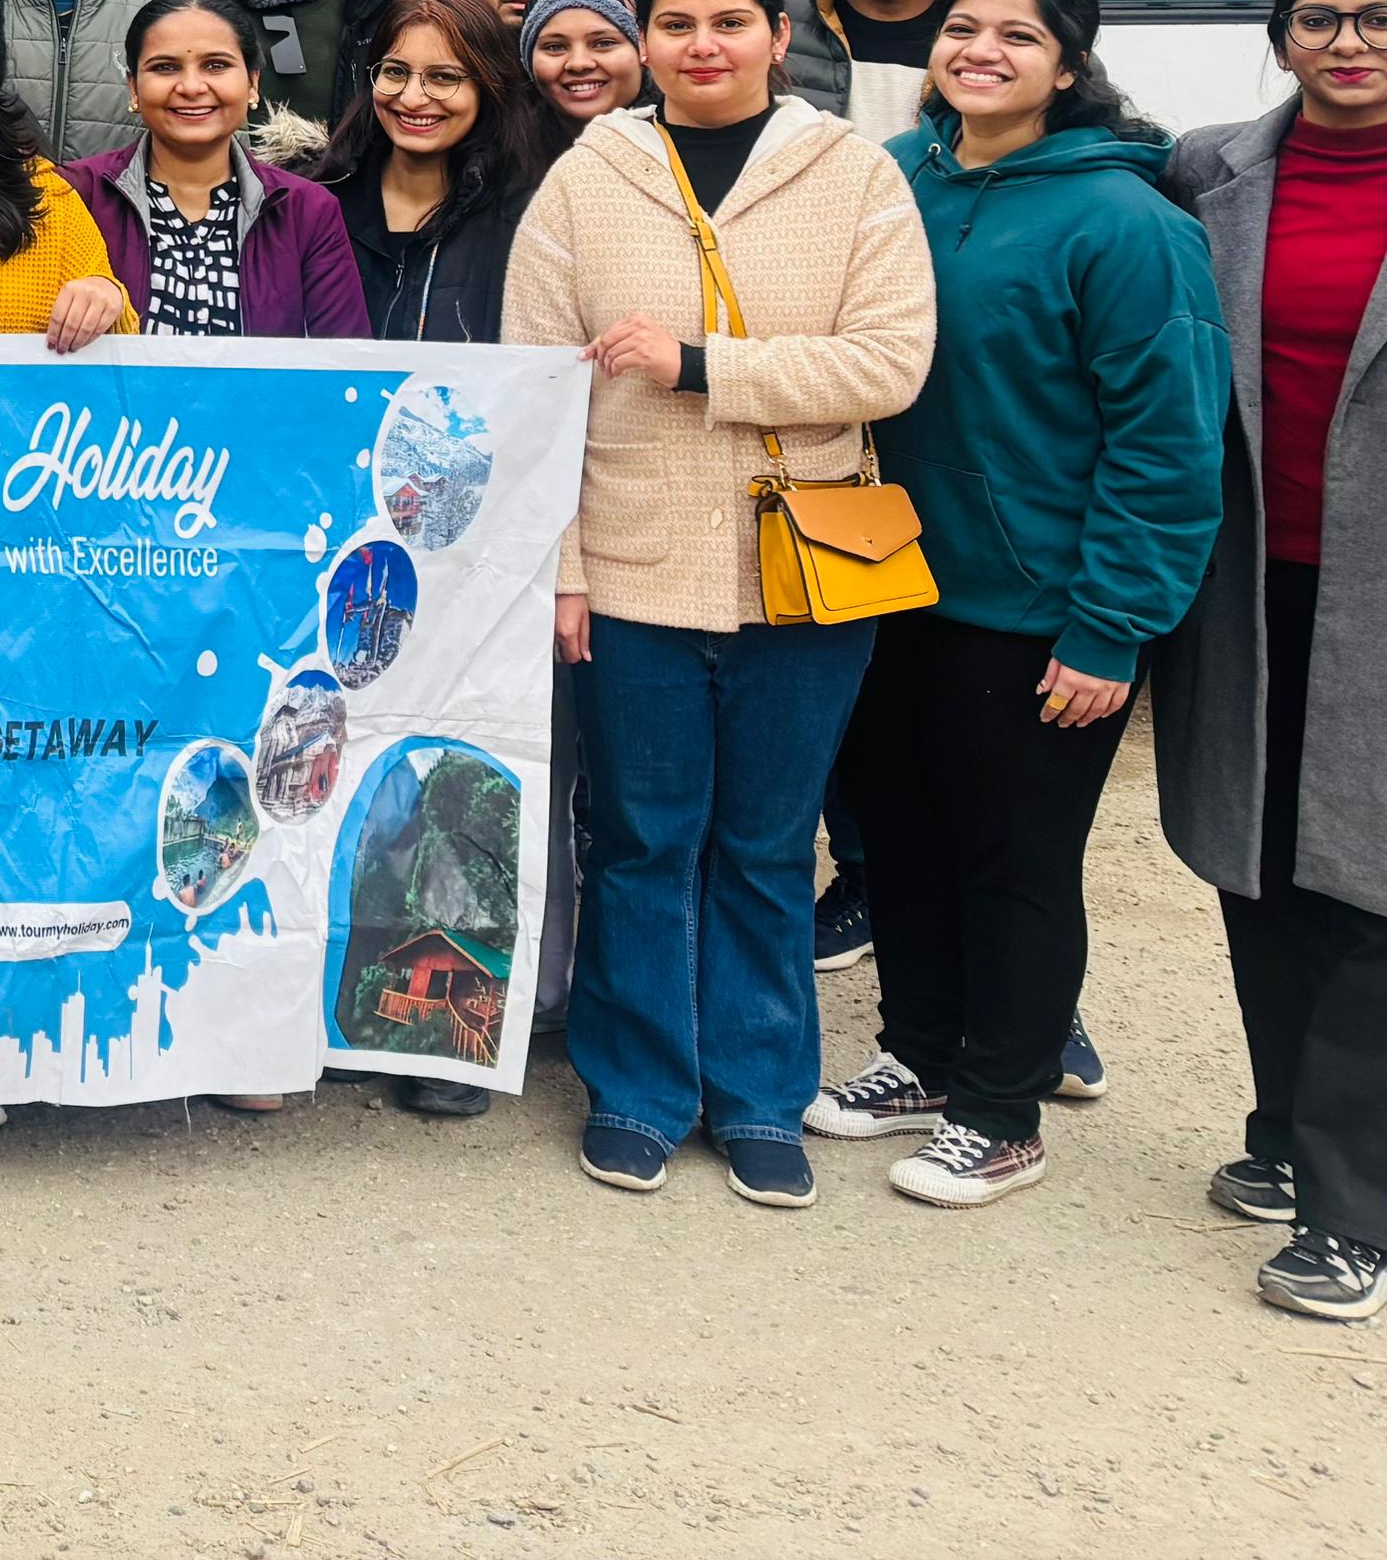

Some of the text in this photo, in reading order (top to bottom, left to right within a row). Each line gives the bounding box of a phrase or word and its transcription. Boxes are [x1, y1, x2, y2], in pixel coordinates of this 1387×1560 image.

[2, 402, 229, 539] Holiday
[4, 537, 64, 575] with
[73, 536, 218, 577] Excellence
